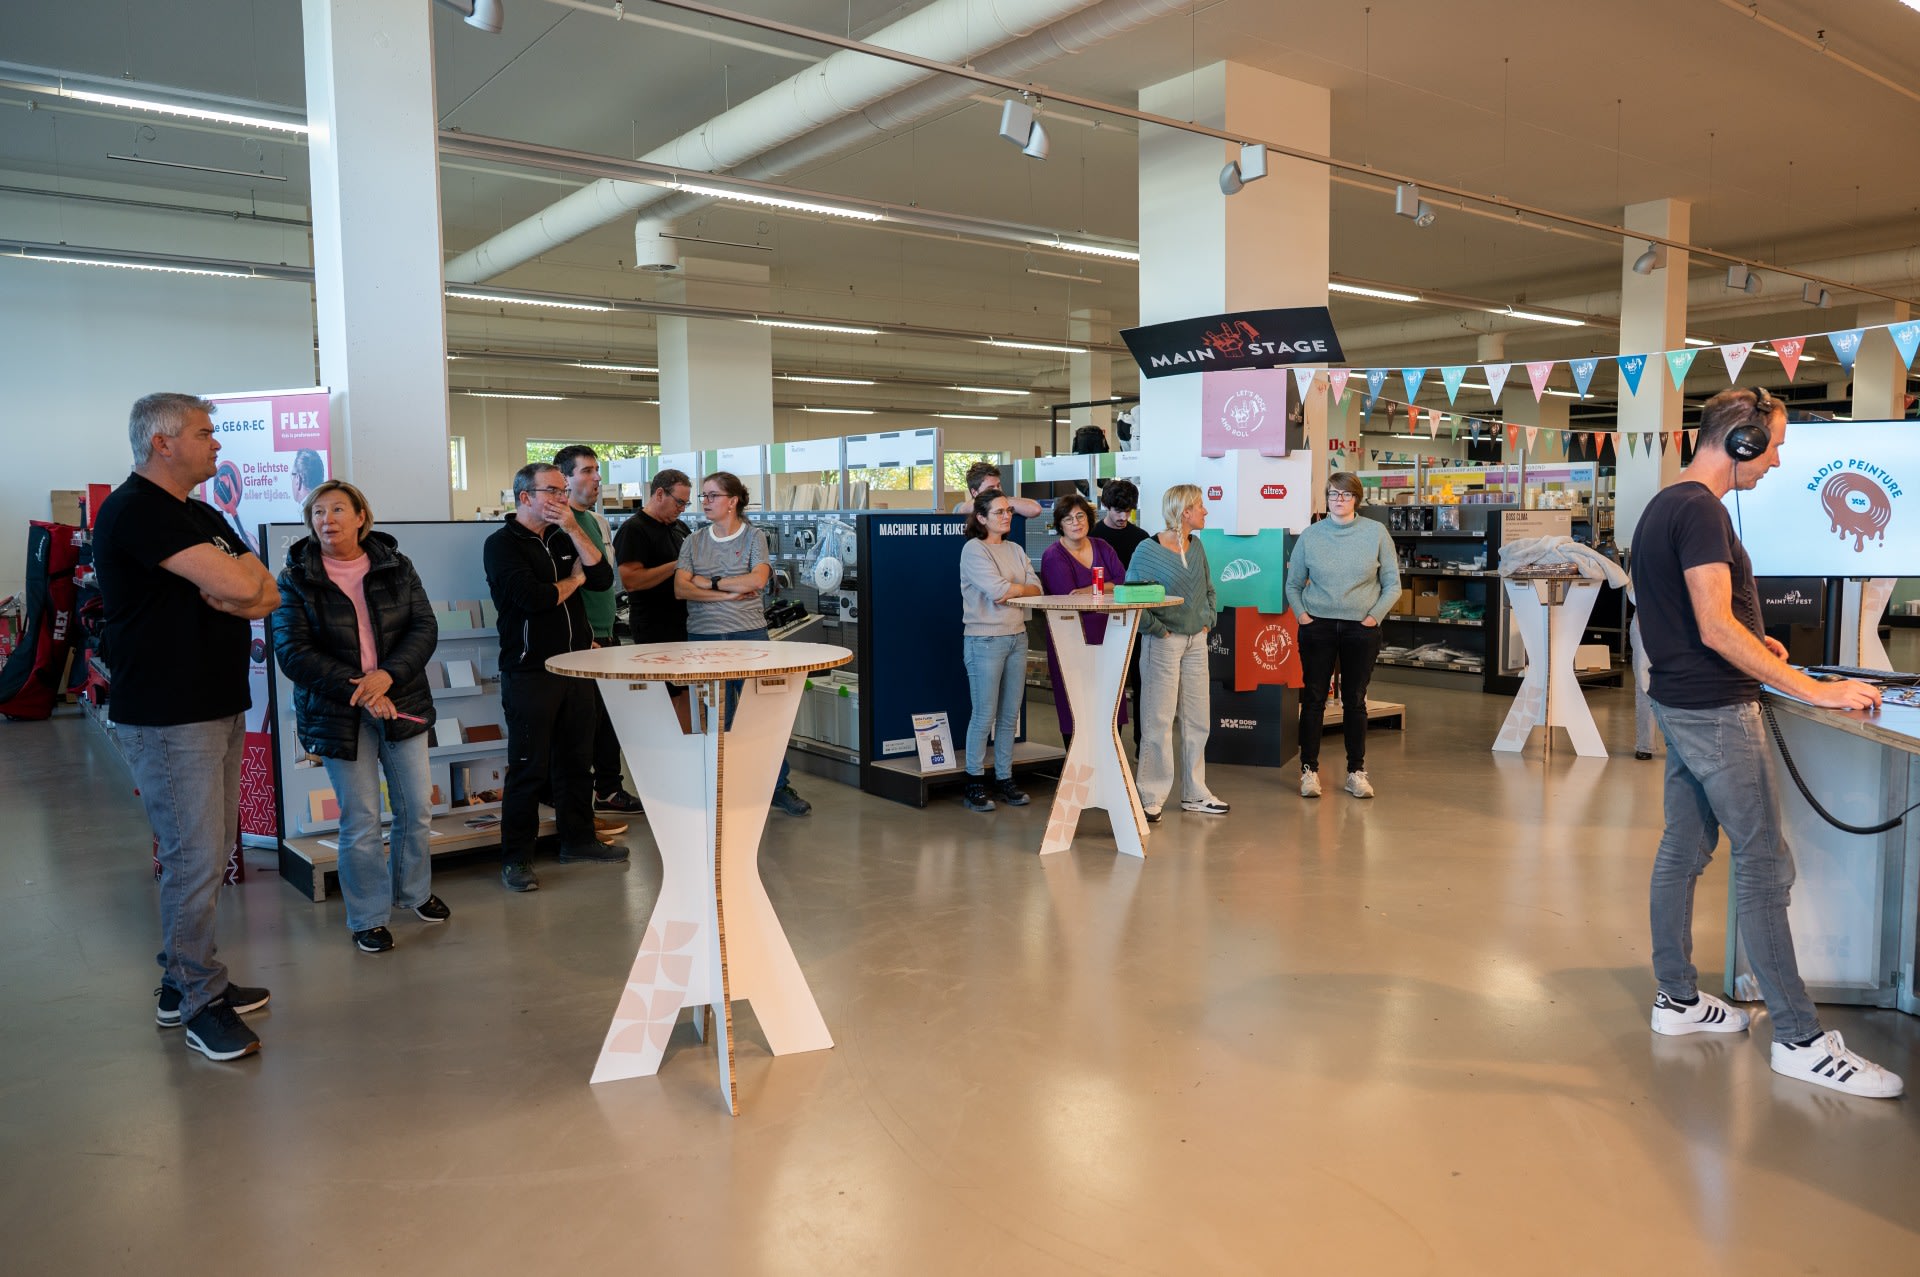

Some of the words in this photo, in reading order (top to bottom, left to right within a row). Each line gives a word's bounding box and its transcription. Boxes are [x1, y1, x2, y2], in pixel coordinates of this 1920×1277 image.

[1150, 347, 1215, 368] MAIN
[1248, 339, 1328, 356] STAGE
[1253, 393, 1267, 412] ROCK
[280, 411, 320, 430] FLEX
[1221, 417, 1232, 432] AND
[1231, 430, 1249, 438] ROLL
[243, 463, 256, 473] De
[257, 462, 289, 473] lichtste
[1807, 459, 1844, 492] RADIO
[1848, 458, 1903, 499] PEINTURE
[1263, 486, 1284, 495] altrex
[879, 523, 918, 536] MACHINE
[920, 523, 929, 536] IN
[930, 523, 942, 536] DE
[943, 523, 968, 535] KIJKE
[53, 610, 69, 641] FLEX
[1266, 624, 1281, 632] LET'S
[1281, 628, 1293, 646] ROCK
[1218, 647, 1230, 656] FEST
[1252, 651, 1262, 665] AND
[1262, 662, 1278, 671] ROLL
